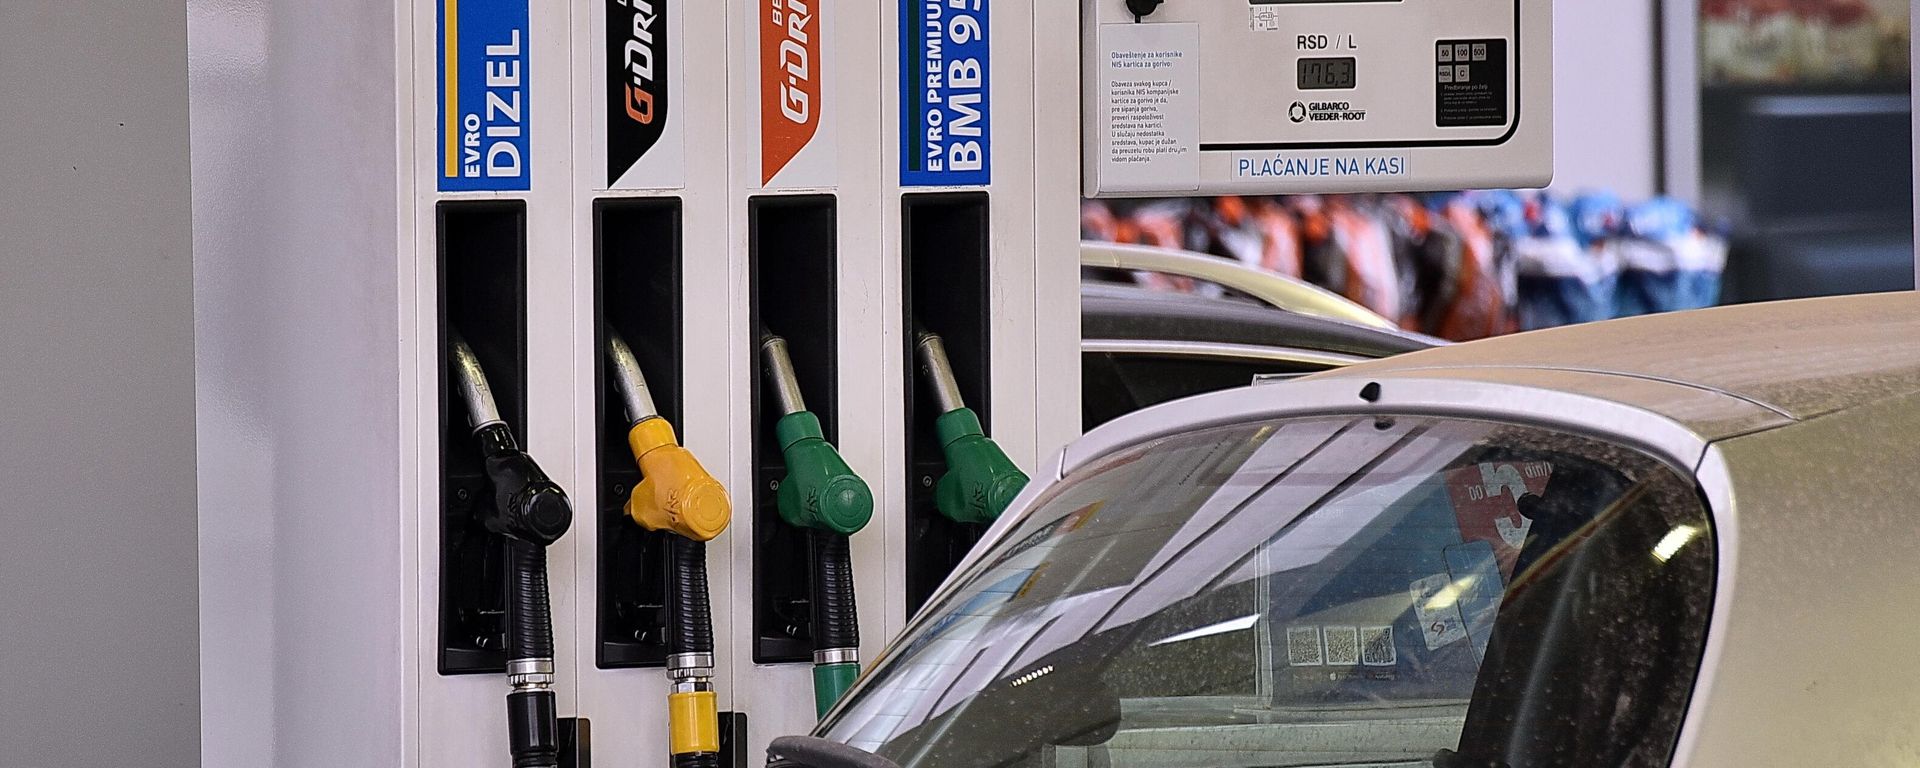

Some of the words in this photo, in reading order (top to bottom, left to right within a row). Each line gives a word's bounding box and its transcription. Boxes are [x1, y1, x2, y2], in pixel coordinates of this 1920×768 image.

[926, 0, 942, 104] PREMIJU
[1111, 51, 1146, 59] Obaveštenje
[1298, 35, 1328, 49] RSD
[1336, 34, 1340, 49] /
[1349, 34, 1356, 48] L
[486, 29, 521, 178] DIZEL
[948, 58, 982, 172] BMB
[1309, 102, 1350, 110] GILBARCO
[1309, 112, 1366, 121] VEEDER-ROOT
[464, 114, 480, 178] EVRO
[927, 108, 943, 172] EVRO
[1239, 154, 1329, 176] PLAĆANJE
[1336, 158, 1360, 175] NA
[1366, 157, 1404, 174] KASI
